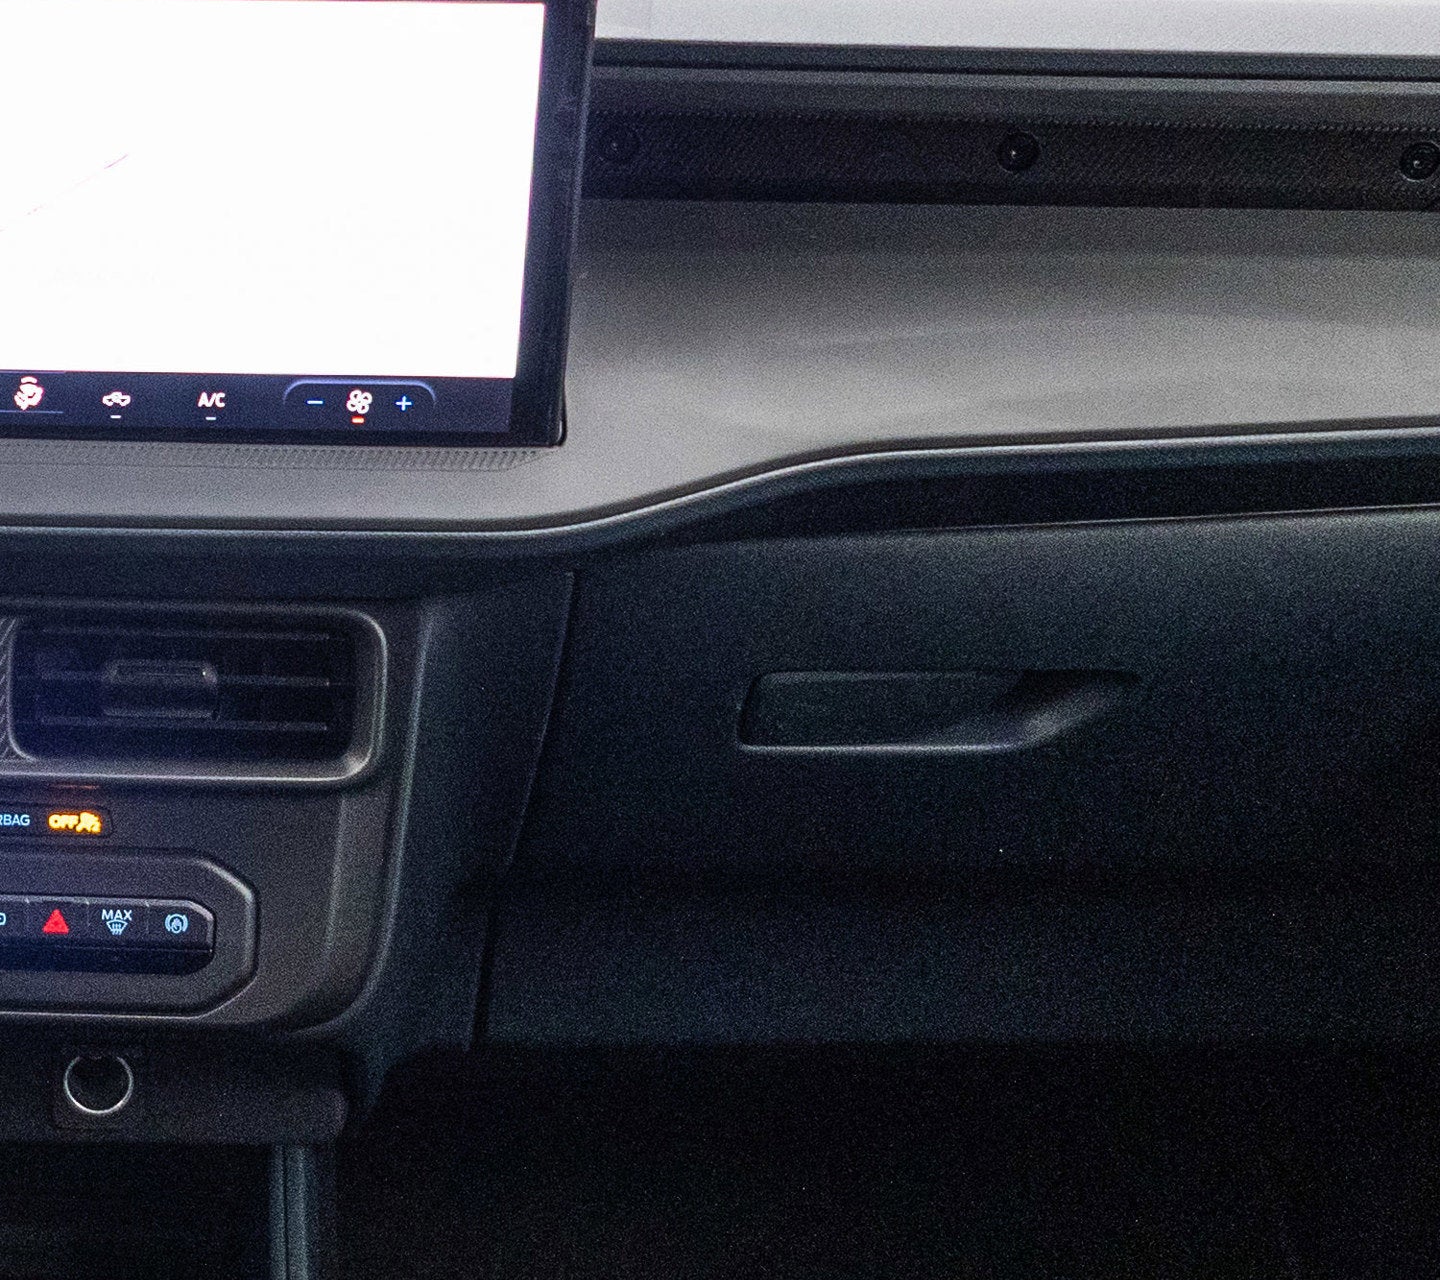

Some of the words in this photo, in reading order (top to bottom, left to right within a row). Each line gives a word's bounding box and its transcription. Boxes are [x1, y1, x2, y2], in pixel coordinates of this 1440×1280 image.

[197, 391, 226, 408] A/C
[48, 814, 79, 829] OFF
[101, 909, 132, 920] MAX
